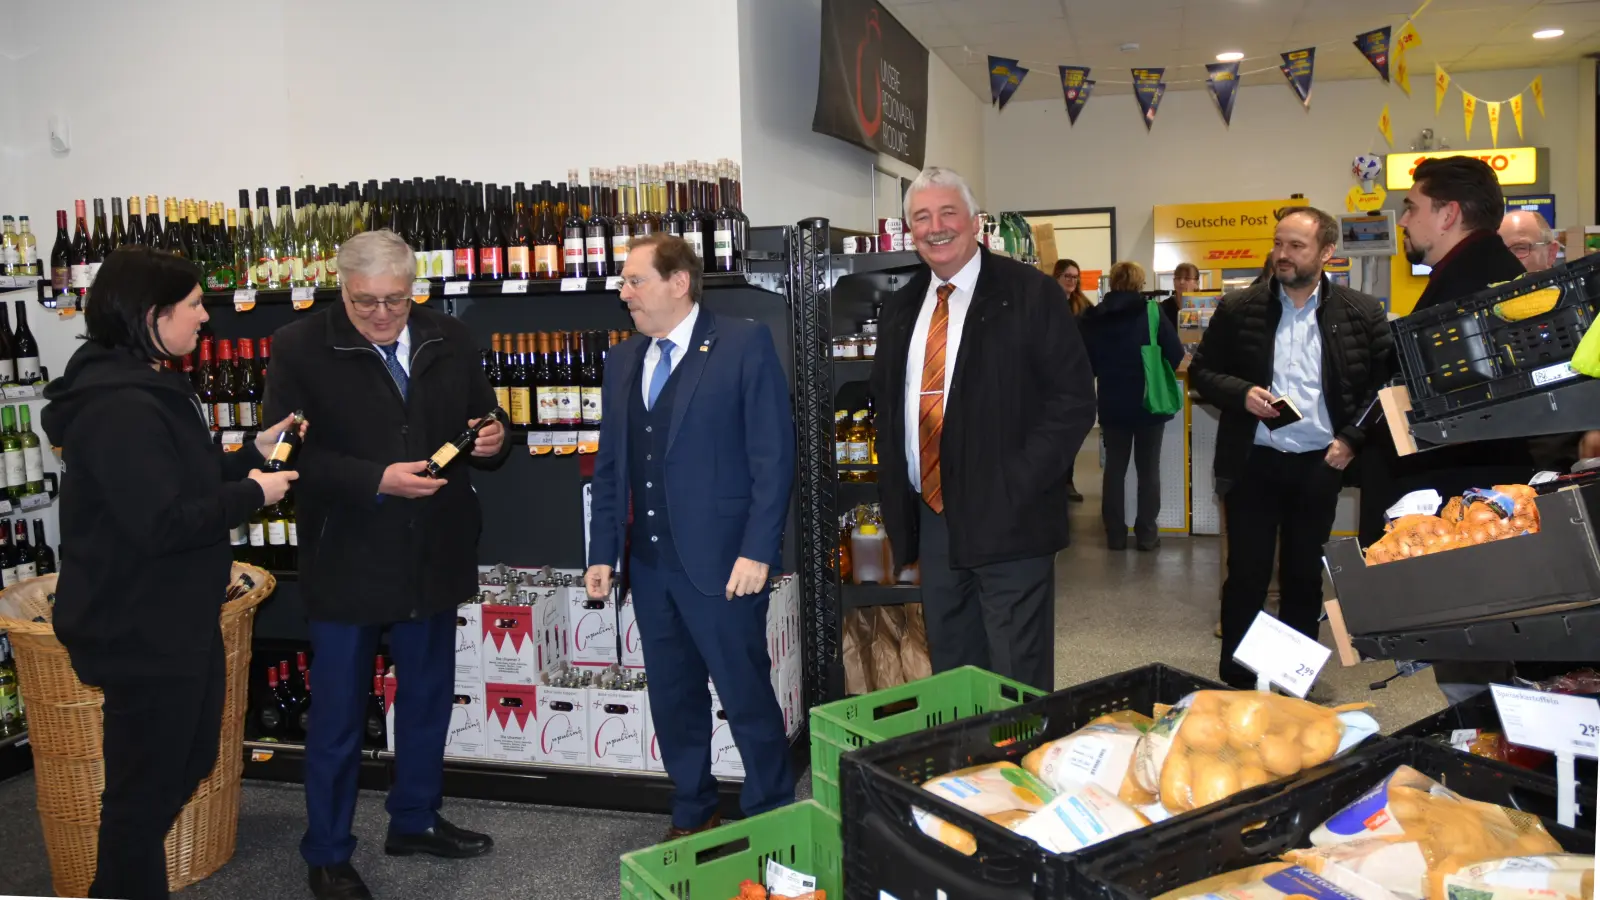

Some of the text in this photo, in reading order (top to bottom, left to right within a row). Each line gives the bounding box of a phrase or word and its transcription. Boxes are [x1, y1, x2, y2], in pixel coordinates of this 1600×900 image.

[880, 57, 901, 94] UNSERE
[881, 90, 915, 131] REGIONALEN
[882, 121, 910, 156] PRODUKTE
[1176, 214, 1268, 229] Deutsche Post
[1208, 249, 1253, 259] DHL
[1295, 663, 1315, 677] 2.99
